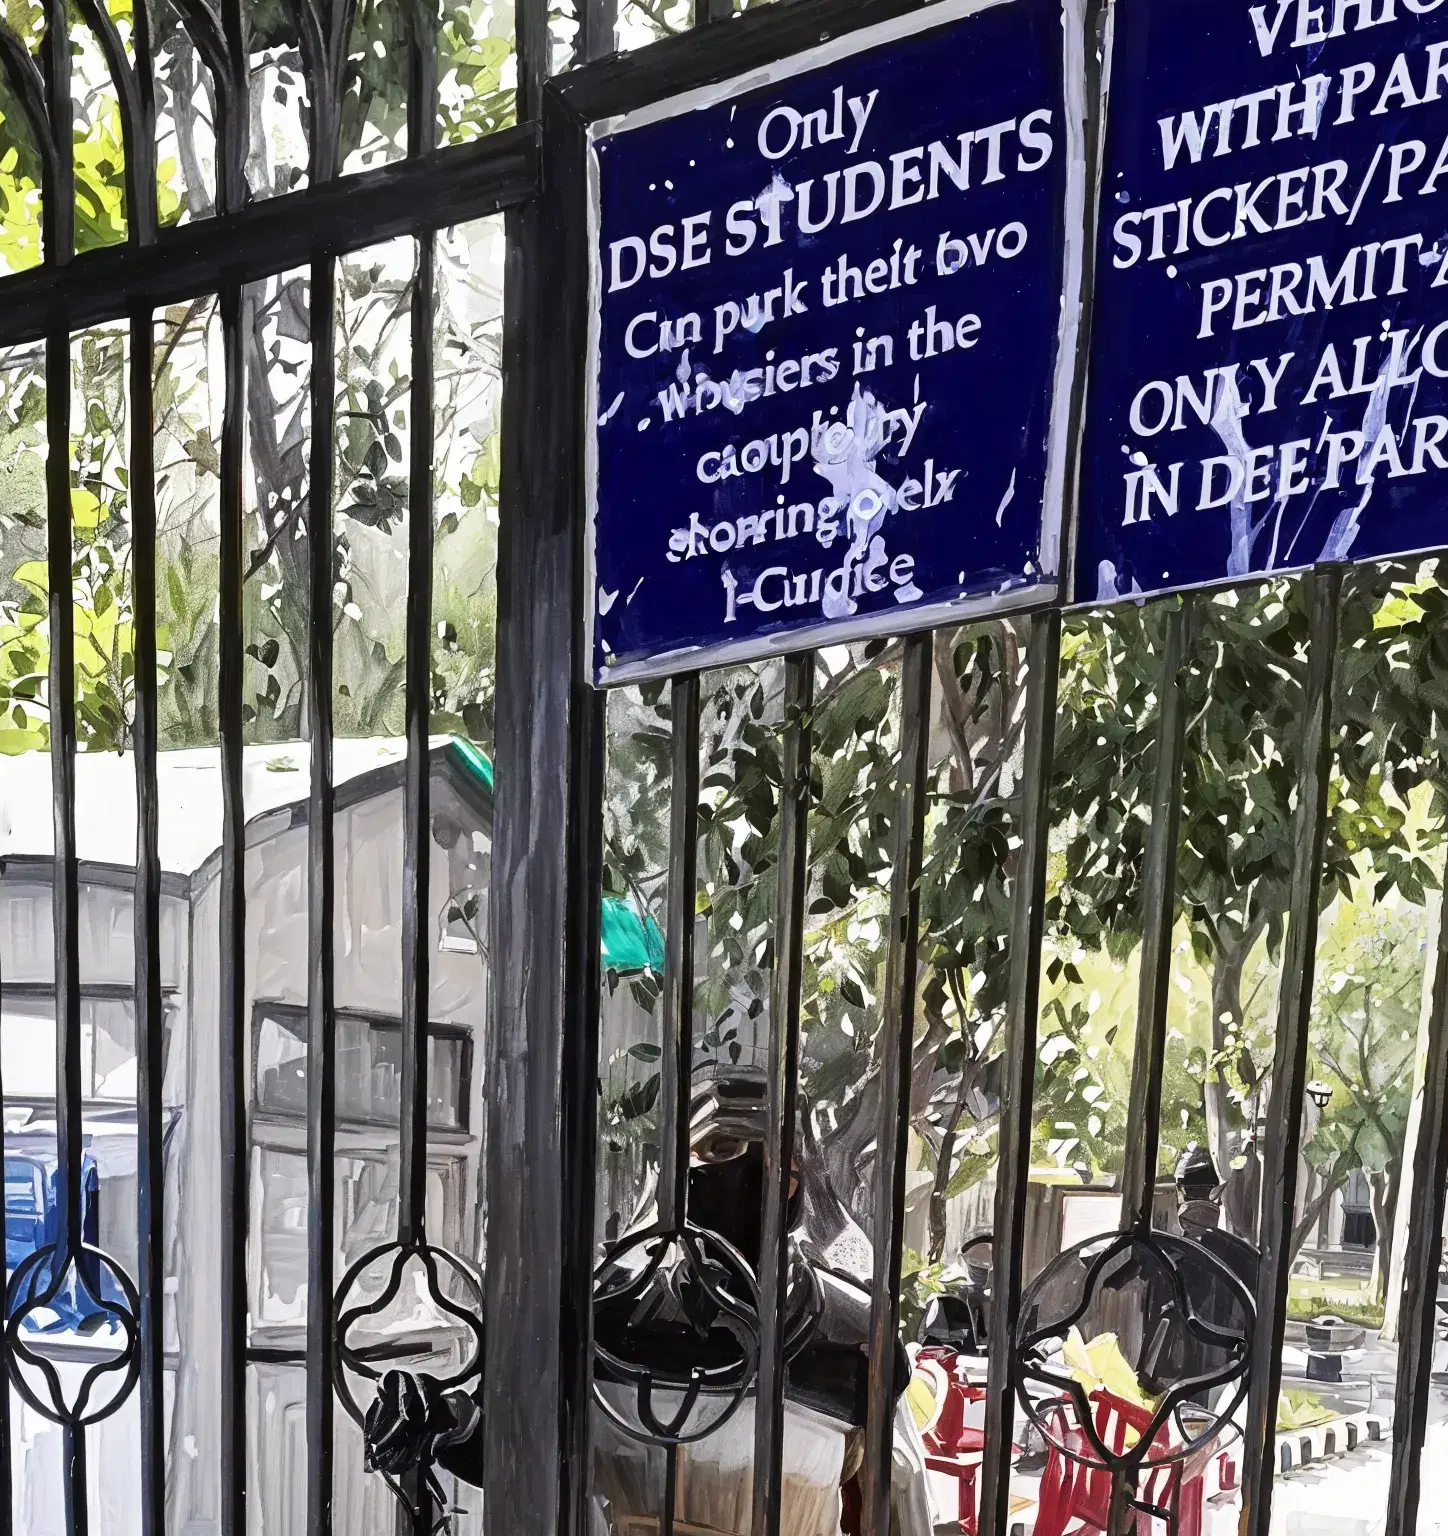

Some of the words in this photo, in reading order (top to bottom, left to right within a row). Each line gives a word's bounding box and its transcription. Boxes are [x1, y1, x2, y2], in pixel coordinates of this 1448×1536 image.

[757, 85, 880, 160] Only
[1156, 72, 1331, 172] WITH
[607, 210, 712, 293] DSE
[725, 108, 1054, 257] STUDENTS
[852, 326, 894, 376] in
[907, 304, 982, 361] the
[1120, 459, 1183, 527] IN
